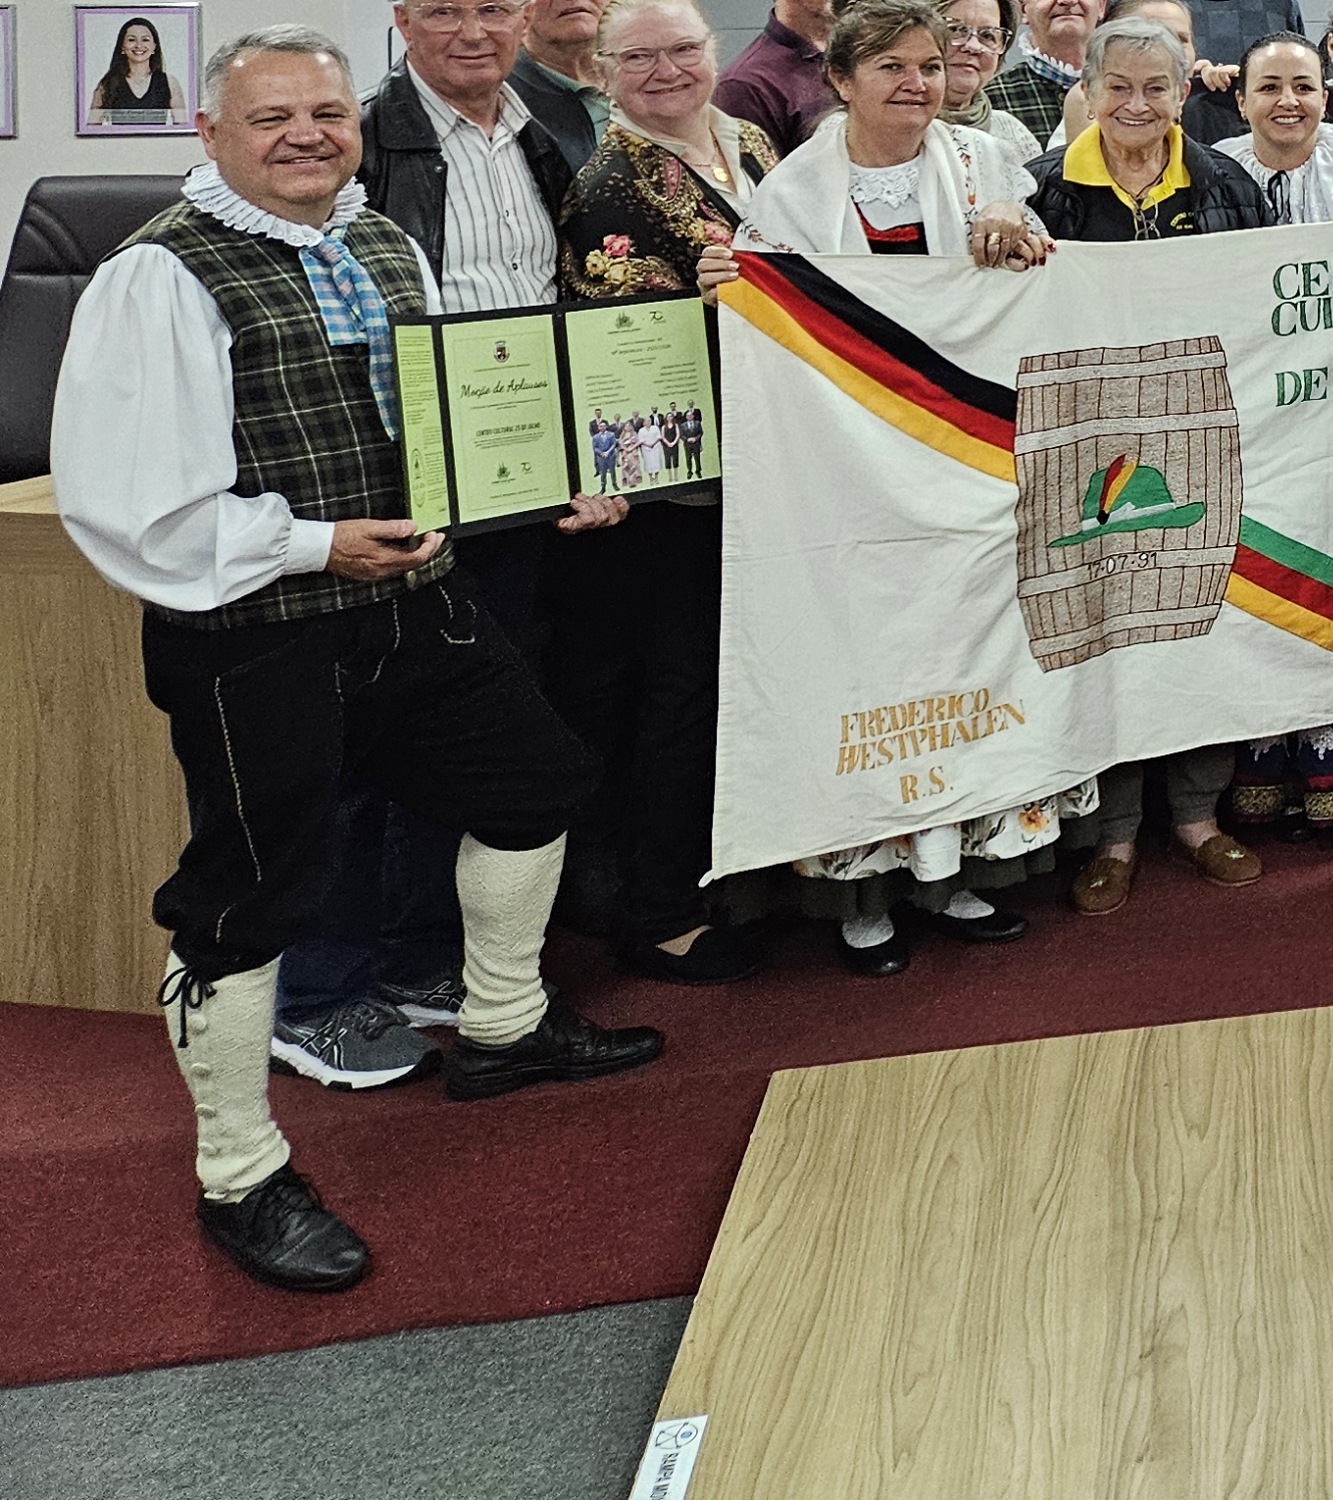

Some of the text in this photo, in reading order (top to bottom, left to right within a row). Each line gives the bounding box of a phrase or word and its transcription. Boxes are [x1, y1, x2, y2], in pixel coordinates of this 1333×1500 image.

[1275, 367, 1328, 407] DE
[835, 699, 1026, 777] WESTPHALEN
[840, 687, 990, 744] FREDERICO
